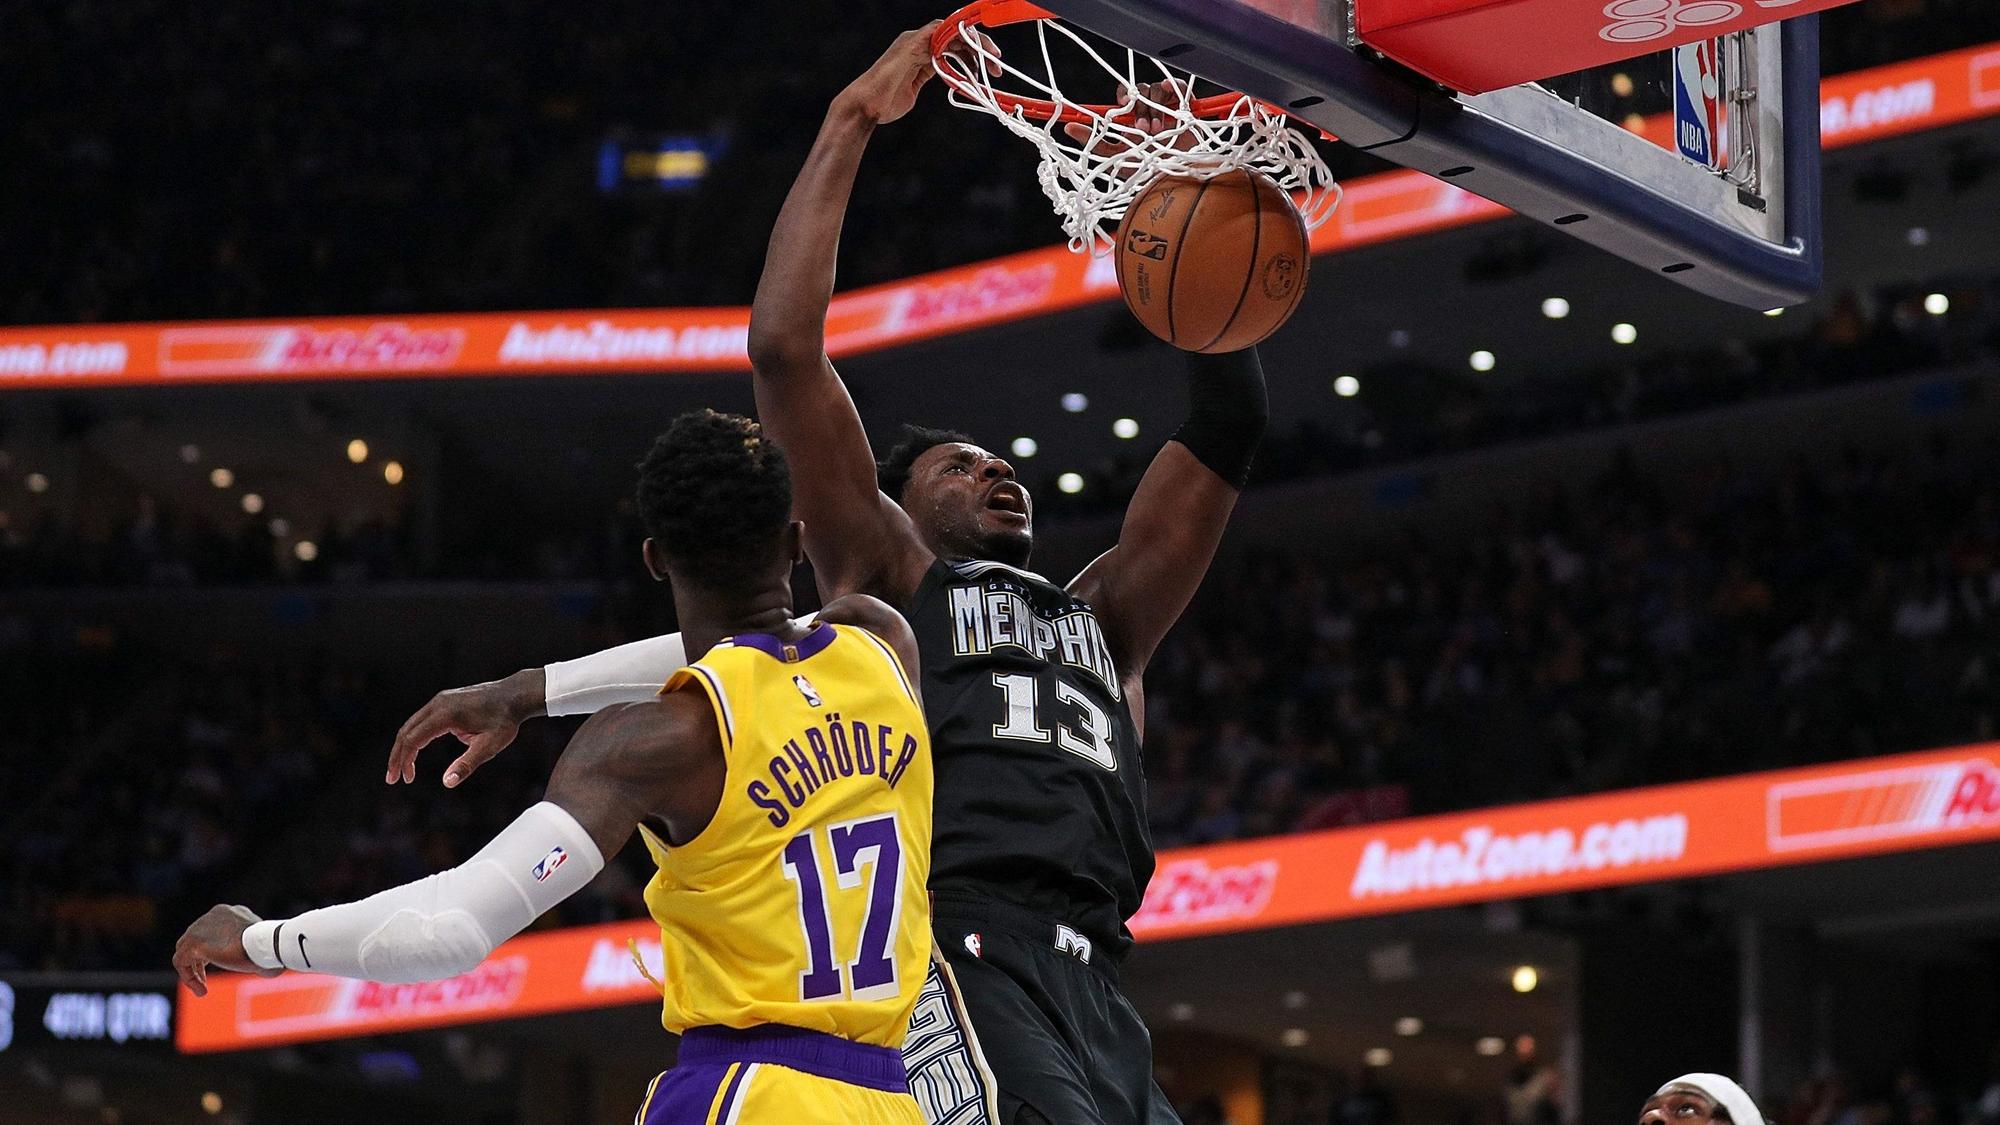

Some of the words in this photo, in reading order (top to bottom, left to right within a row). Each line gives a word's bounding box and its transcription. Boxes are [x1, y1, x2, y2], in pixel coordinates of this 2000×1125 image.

[1681, 119, 1703, 156] NBA
[949, 585, 1121, 702] MEMPHIS
[746, 713, 918, 828] SCHRÖDER
[992, 671, 1118, 772] 13
[1350, 812, 1689, 899] AutoZone.com
[780, 811, 901, 1002] 17
[107, 992, 172, 1044] QTR
